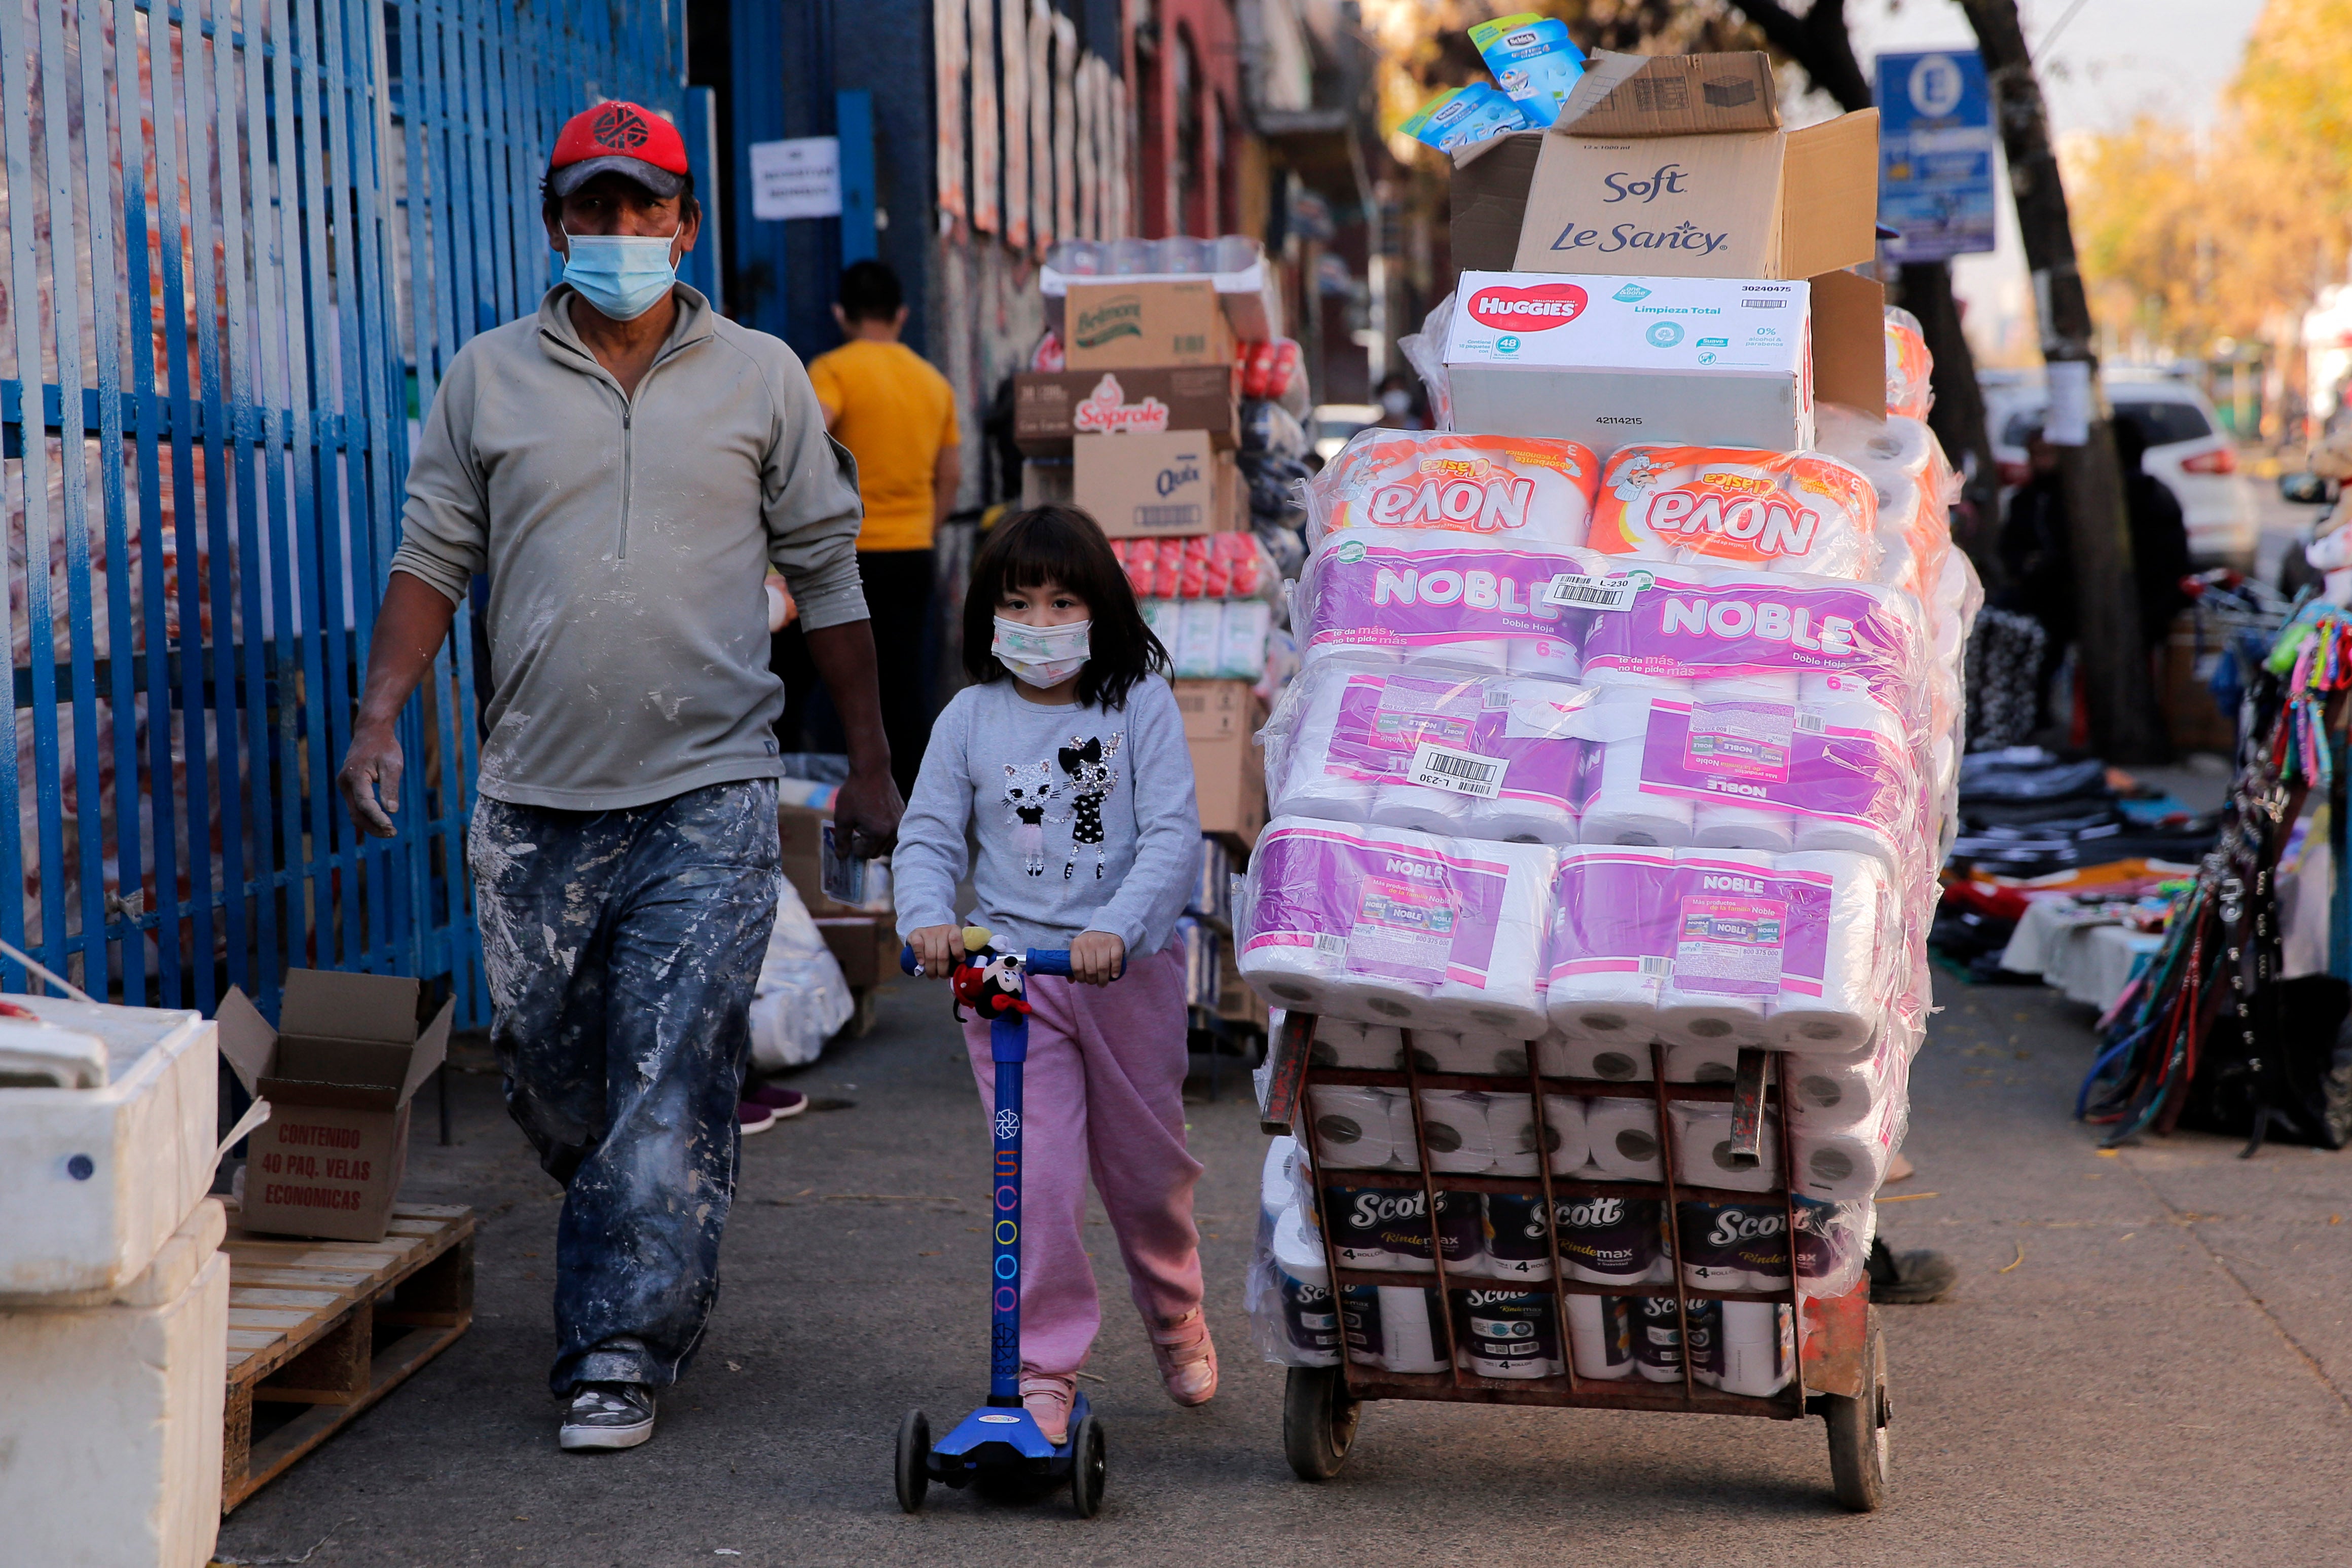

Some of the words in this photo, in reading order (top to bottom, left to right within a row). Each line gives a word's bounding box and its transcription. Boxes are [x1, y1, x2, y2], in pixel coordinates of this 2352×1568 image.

[1509, 33, 1535, 45] Schick
[1603, 164, 1688, 203] Soft
[1550, 223, 1598, 250] Le
[1598, 223, 1728, 256] Sancy
[1478, 296, 1576, 317] HUGGIES
[1635, 306, 1688, 314] Limpieza
[1078, 404, 1164, 429] Soprole
[1596, 417, 1642, 425] 42114215
[1567, 444, 1577, 456] 3
[1419, 458, 1491, 478] Clásica
[1514, 455, 1572, 470] Absorbente
[1157, 467, 1200, 498] Quix
[1703, 473, 1777, 495] Clásica
[1850, 478, 1860, 491] 3
[1370, 480, 1533, 530] Nova
[1646, 491, 1820, 555] Nova
[1729, 542, 1747, 550] Toallas
[1600, 579, 1628, 587] L-230
[1374, 568, 1560, 619] NOBLE
[1358, 625, 1386, 634] más
[1502, 618, 1530, 629] Doble
[1533, 623, 1555, 633] Hoja
[1662, 599, 1854, 655] NOBLE
[1357, 636, 1377, 644] pide
[1379, 635, 1408, 645] más
[1536, 641, 1551, 656] 6
[1646, 655, 1674, 665] más
[1792, 652, 1821, 665] Doble
[1823, 659, 1847, 668] Hoja
[1645, 665, 1665, 674] pide
[1667, 665, 1696, 677] más
[1826, 676, 1841, 690] 6
[1408, 720, 1438, 729] NOBLE
[1380, 735, 1403, 743] Noble
[1723, 743, 1753, 754] NOBLE
[1695, 757, 1720, 767] Noble
[1419, 773, 1450, 788] L-230
[1706, 779, 1767, 797] NOBLE
[1385, 858, 1444, 880] NOBLE
[1386, 883, 1415, 892] productos
[1704, 875, 1765, 894] NOBLE
[1406, 891, 1428, 900] familia
[1428, 895, 1451, 905] Noble
[1365, 901, 1386, 909] NOBLE
[1752, 907, 1775, 916] Noble
[1393, 909, 1422, 921] NOBLE
[1432, 915, 1452, 923] NOBLE
[1354, 926, 1371, 935] Softys
[1717, 924, 1747, 935] NOBLE
[278, 1124, 360, 1150] CONTENIDO
[261, 1153, 281, 1175] 40
[286, 1156, 319, 1179] PAQ.
[326, 1159, 371, 1181] VELAS
[265, 1184, 361, 1211] ECONOMICAS
[1342, 1249, 1356, 1260] 4
[1558, 1239, 1633, 1259] Rindemax
[1515, 1261, 1530, 1273] 4
[1695, 1267, 1709, 1279] 4
[1499, 1361, 1510, 1370] 4
